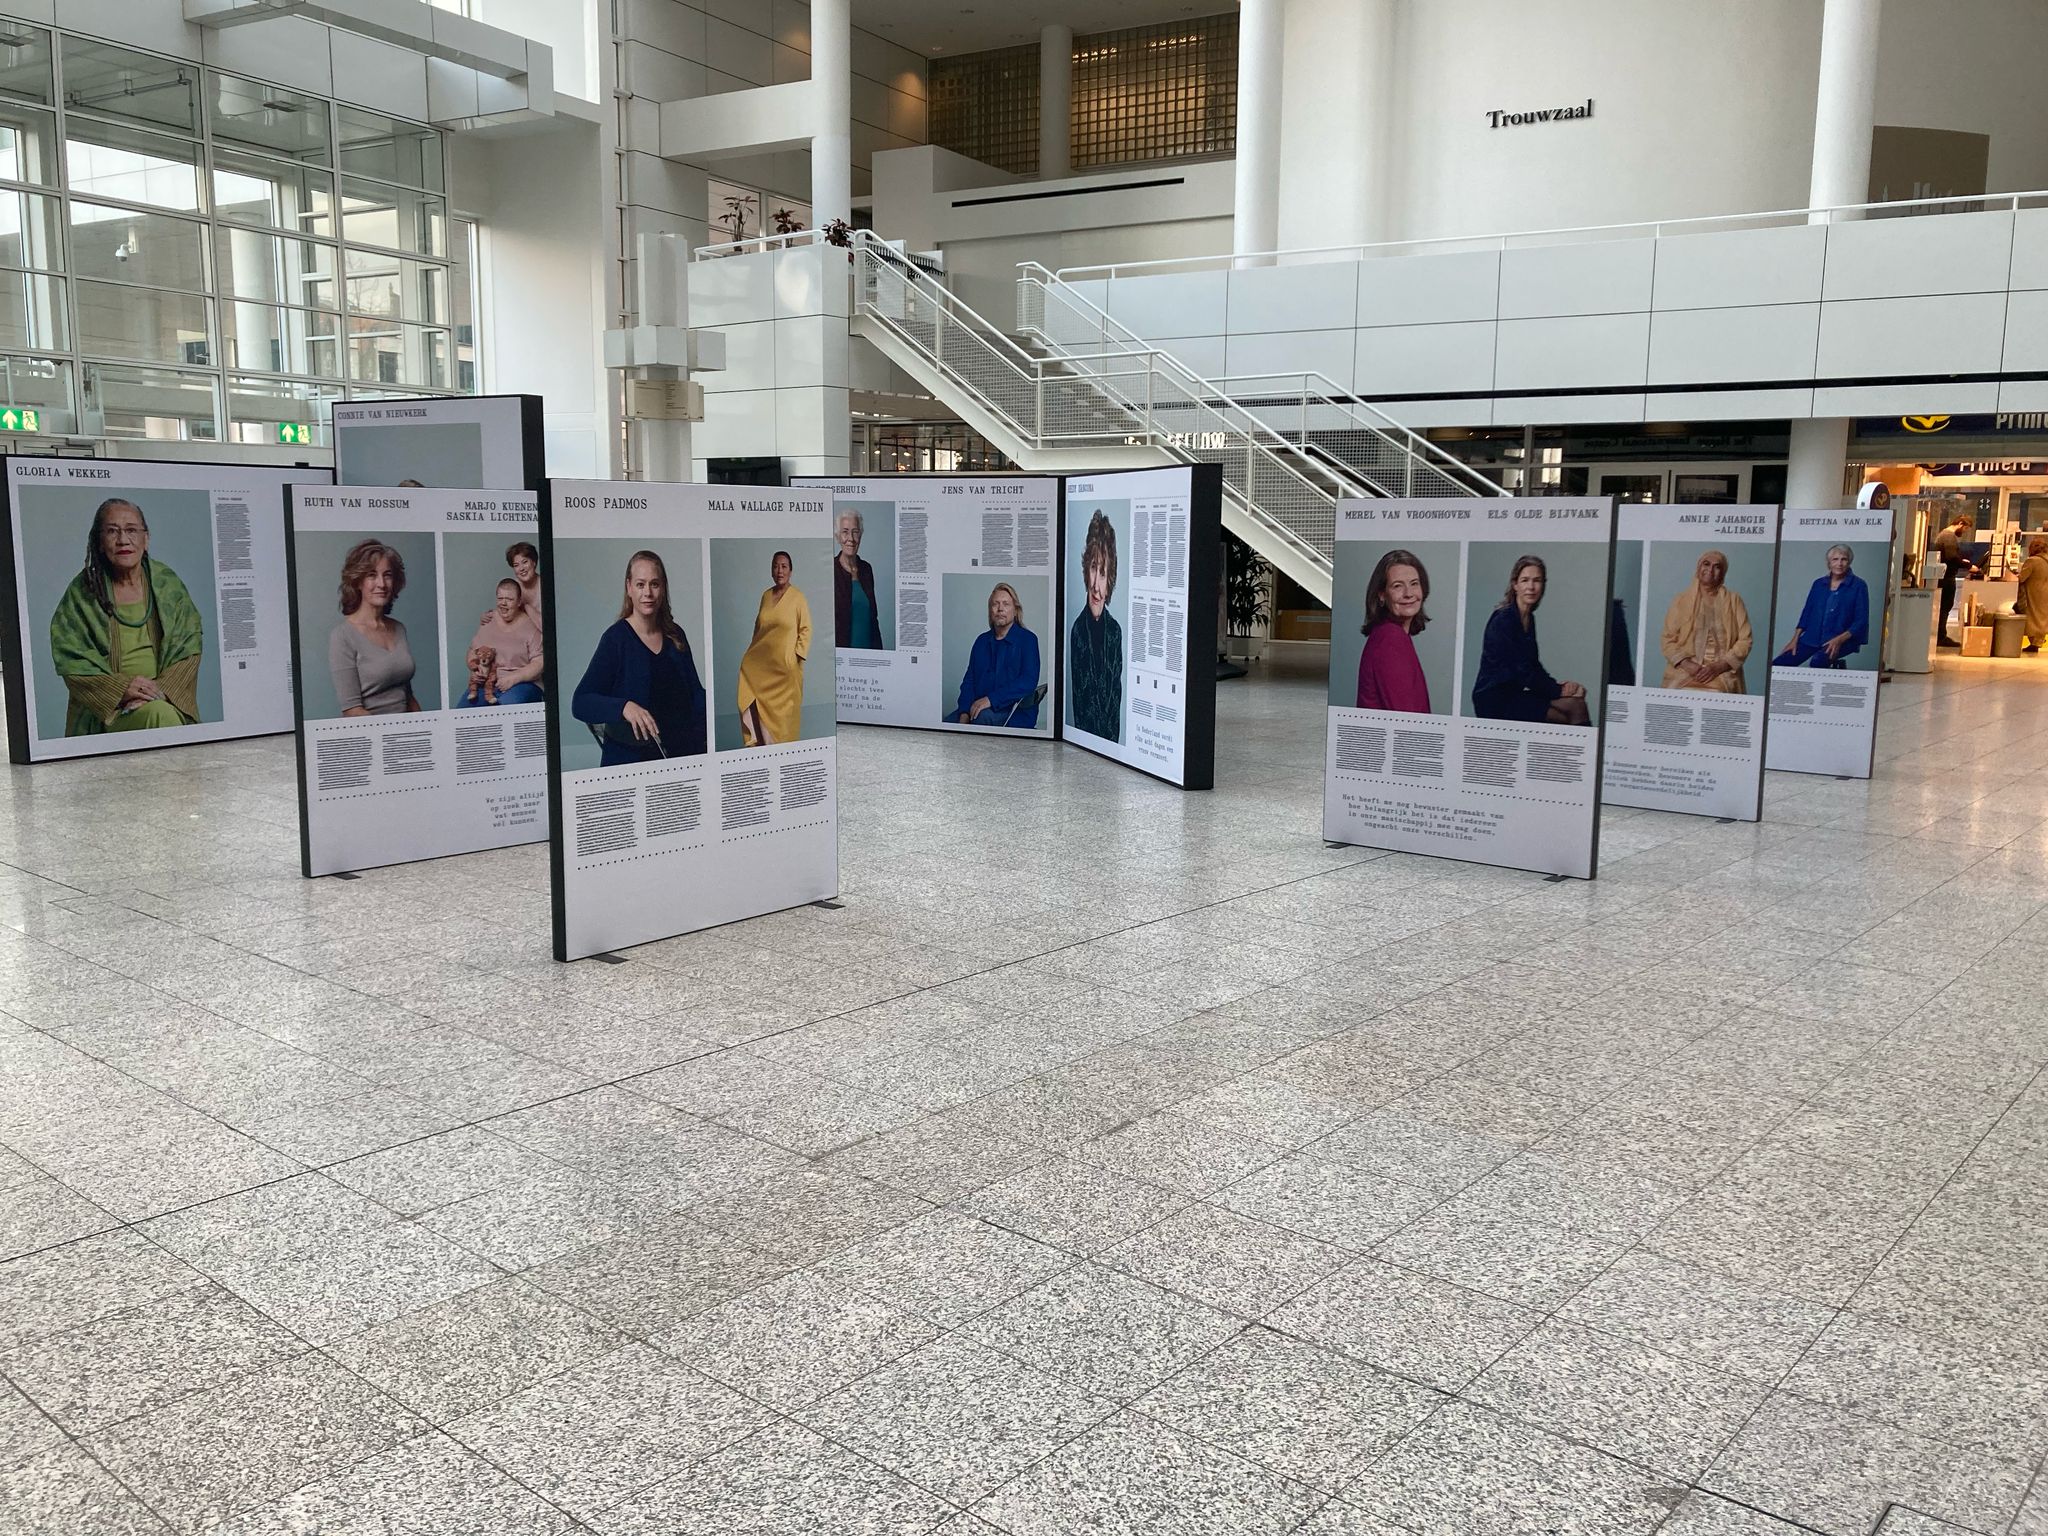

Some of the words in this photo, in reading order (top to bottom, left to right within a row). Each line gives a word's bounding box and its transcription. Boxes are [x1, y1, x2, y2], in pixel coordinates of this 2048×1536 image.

[1486, 98, 1592, 128] Trouwzaal
[337, 410, 365, 420] CONNIE
[368, 410, 381, 419] VAN
[385, 408, 427, 418] NIEUWKERK
[16, 466, 61, 477] GLORIA
[68, 468, 112, 478] WEKKER
[942, 485, 964, 495] JENS
[969, 485, 986, 494] VAN
[990, 485, 1025, 495] TRICHT
[304, 497, 334, 507] RUTH
[340, 498, 362, 508] VAN
[368, 498, 410, 508] ROSSUM
[464, 501, 497, 511] MARJO
[564, 496, 596, 508] ROOS
[603, 497, 648, 510] PADMOS
[708, 499, 735, 511] MALA
[740, 500, 784, 512] WALLAGE
[789, 501, 824, 512] PAIDIN
[446, 511, 485, 521] SASKIA
[1345, 510, 1376, 520] MEREL
[1381, 510, 1401, 520] VAN
[1406, 509, 1472, 520] VROONHOVEN
[1488, 509, 1509, 519] ELS
[1513, 509, 1543, 519] OLDE
[1548, 508, 1600, 519] BIJVANK
[1679, 514, 1711, 523] ANNIE
[1714, 515, 1766, 524] JAHANGIR
[1799, 518, 1838, 526] BETTINA
[1843, 518, 1861, 526] VAN
[1865, 518, 1883, 526] ELK
